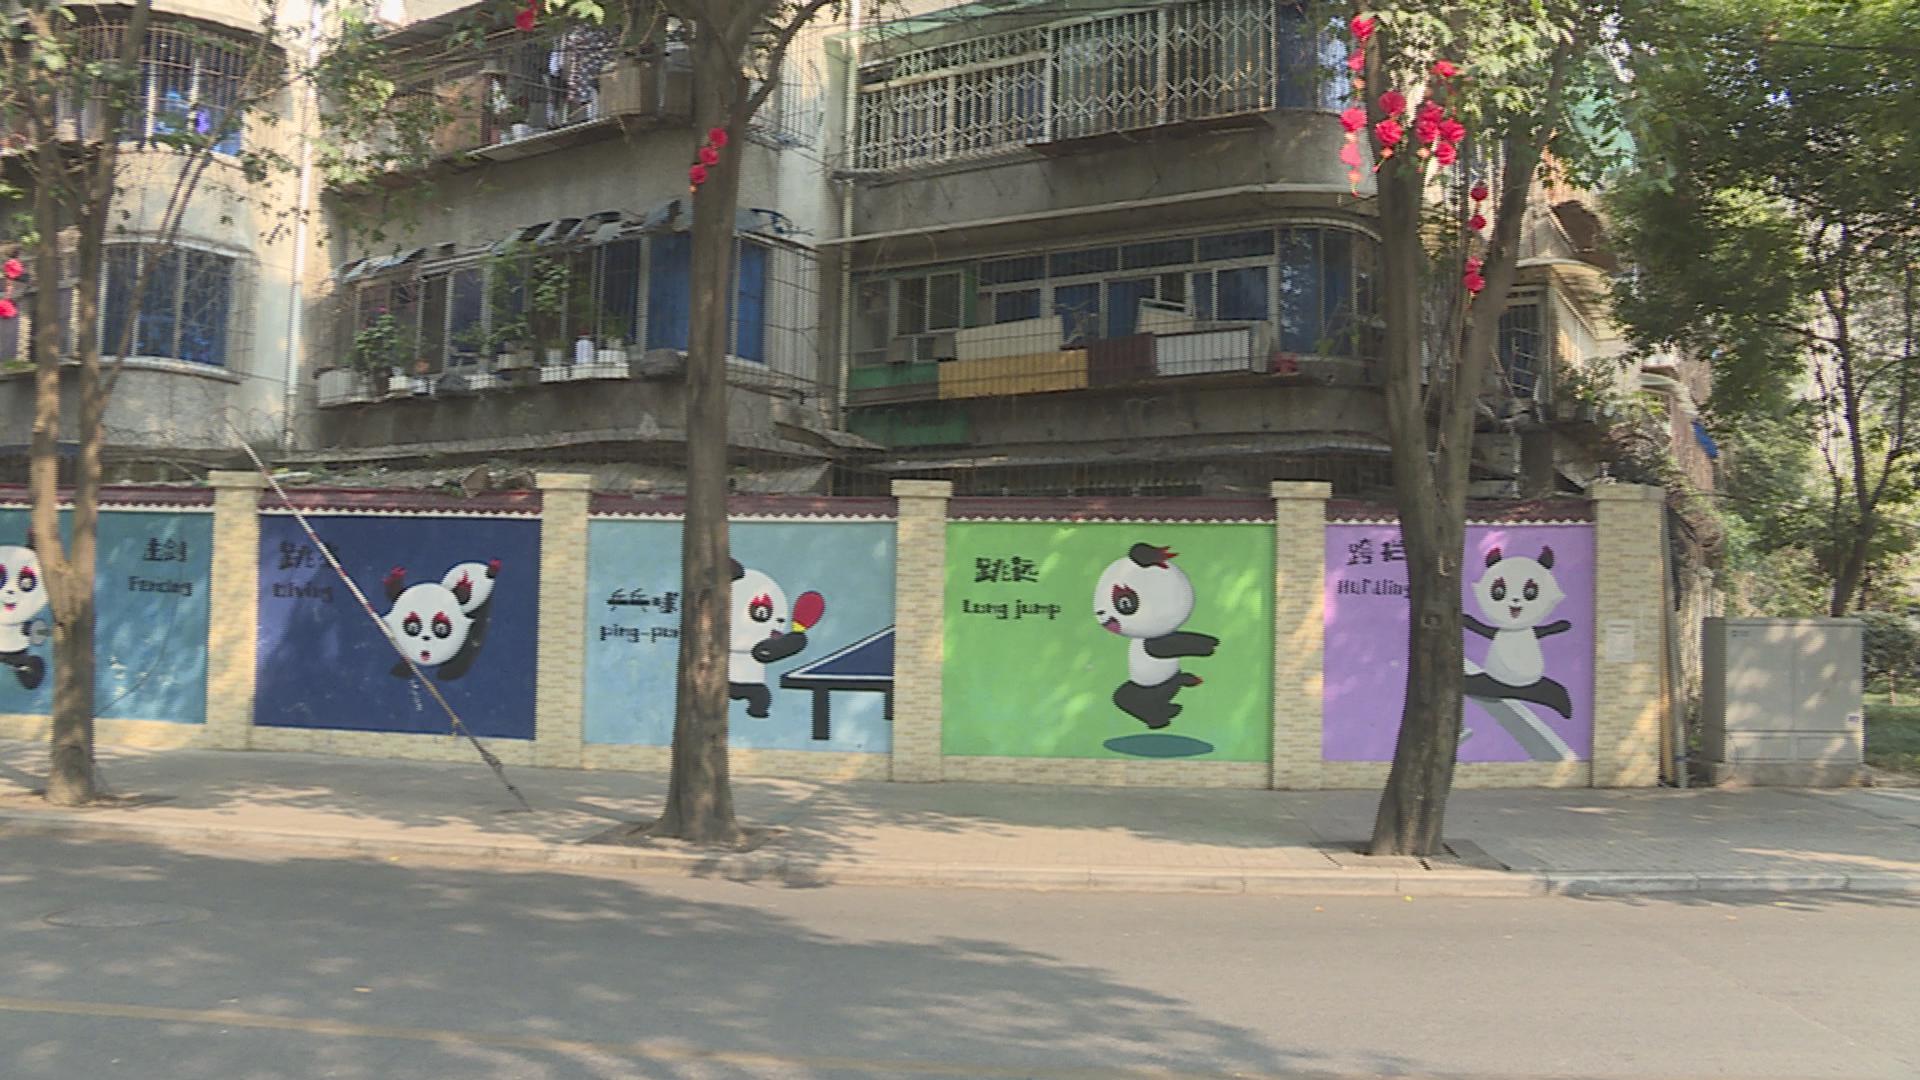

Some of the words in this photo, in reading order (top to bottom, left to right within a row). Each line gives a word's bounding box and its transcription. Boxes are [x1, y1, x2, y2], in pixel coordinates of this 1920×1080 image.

[974, 556, 1039, 582] 跳远
[962, 599, 1007, 619] Long
[1014, 599, 1061, 620] jump
